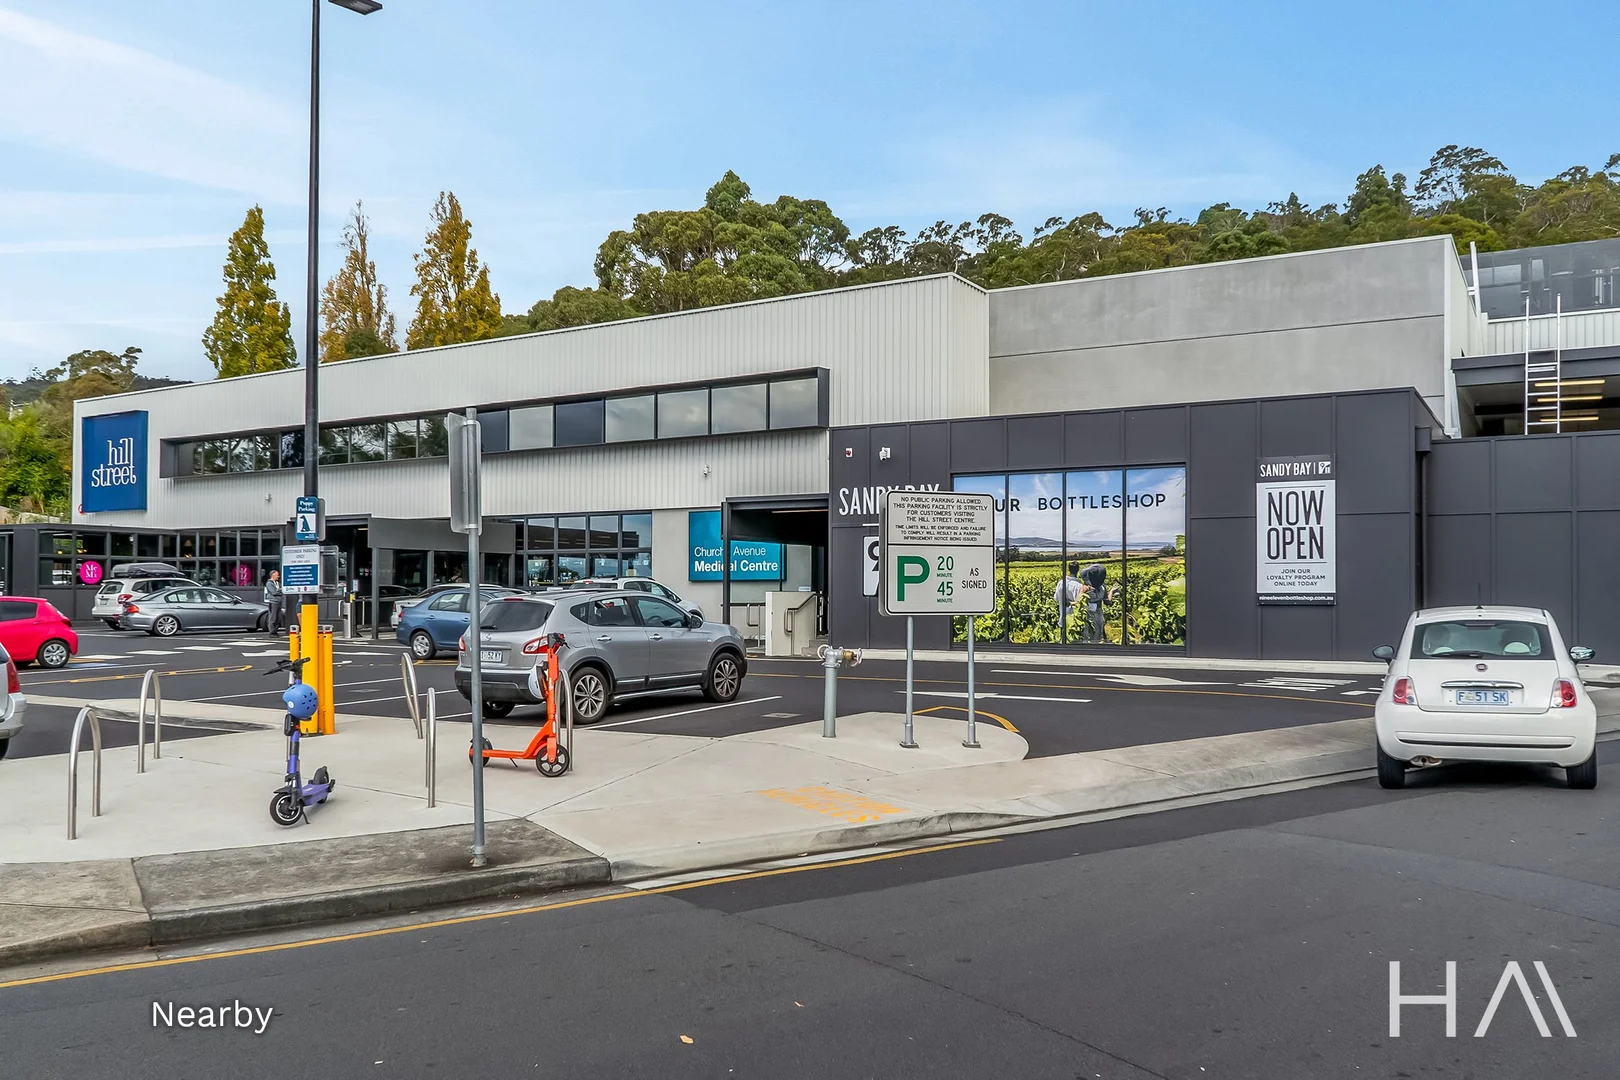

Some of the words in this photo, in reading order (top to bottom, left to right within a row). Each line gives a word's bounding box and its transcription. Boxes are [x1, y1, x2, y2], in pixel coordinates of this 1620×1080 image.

[107, 437, 135, 466] hill
[91, 463, 137, 488] street
[1260, 463, 1291, 478] SANDY
[1293, 462, 1311, 475] BAY
[838, 485, 899, 516] SAND
[994, 498, 1021, 512] UR
[1038, 493, 1166, 511] BOTTLESHOP
[1267, 490, 1325, 526] NOW
[733, 546, 766, 556] Avenue
[1267, 526, 1324, 560] OPEN
[740, 559, 778, 571] Centre
[969, 567, 980, 577] AS
[896, 555, 931, 602] P
[937, 555, 954, 571] 20
[961, 579, 988, 589] SIGNED
[936, 581, 954, 596] 45
